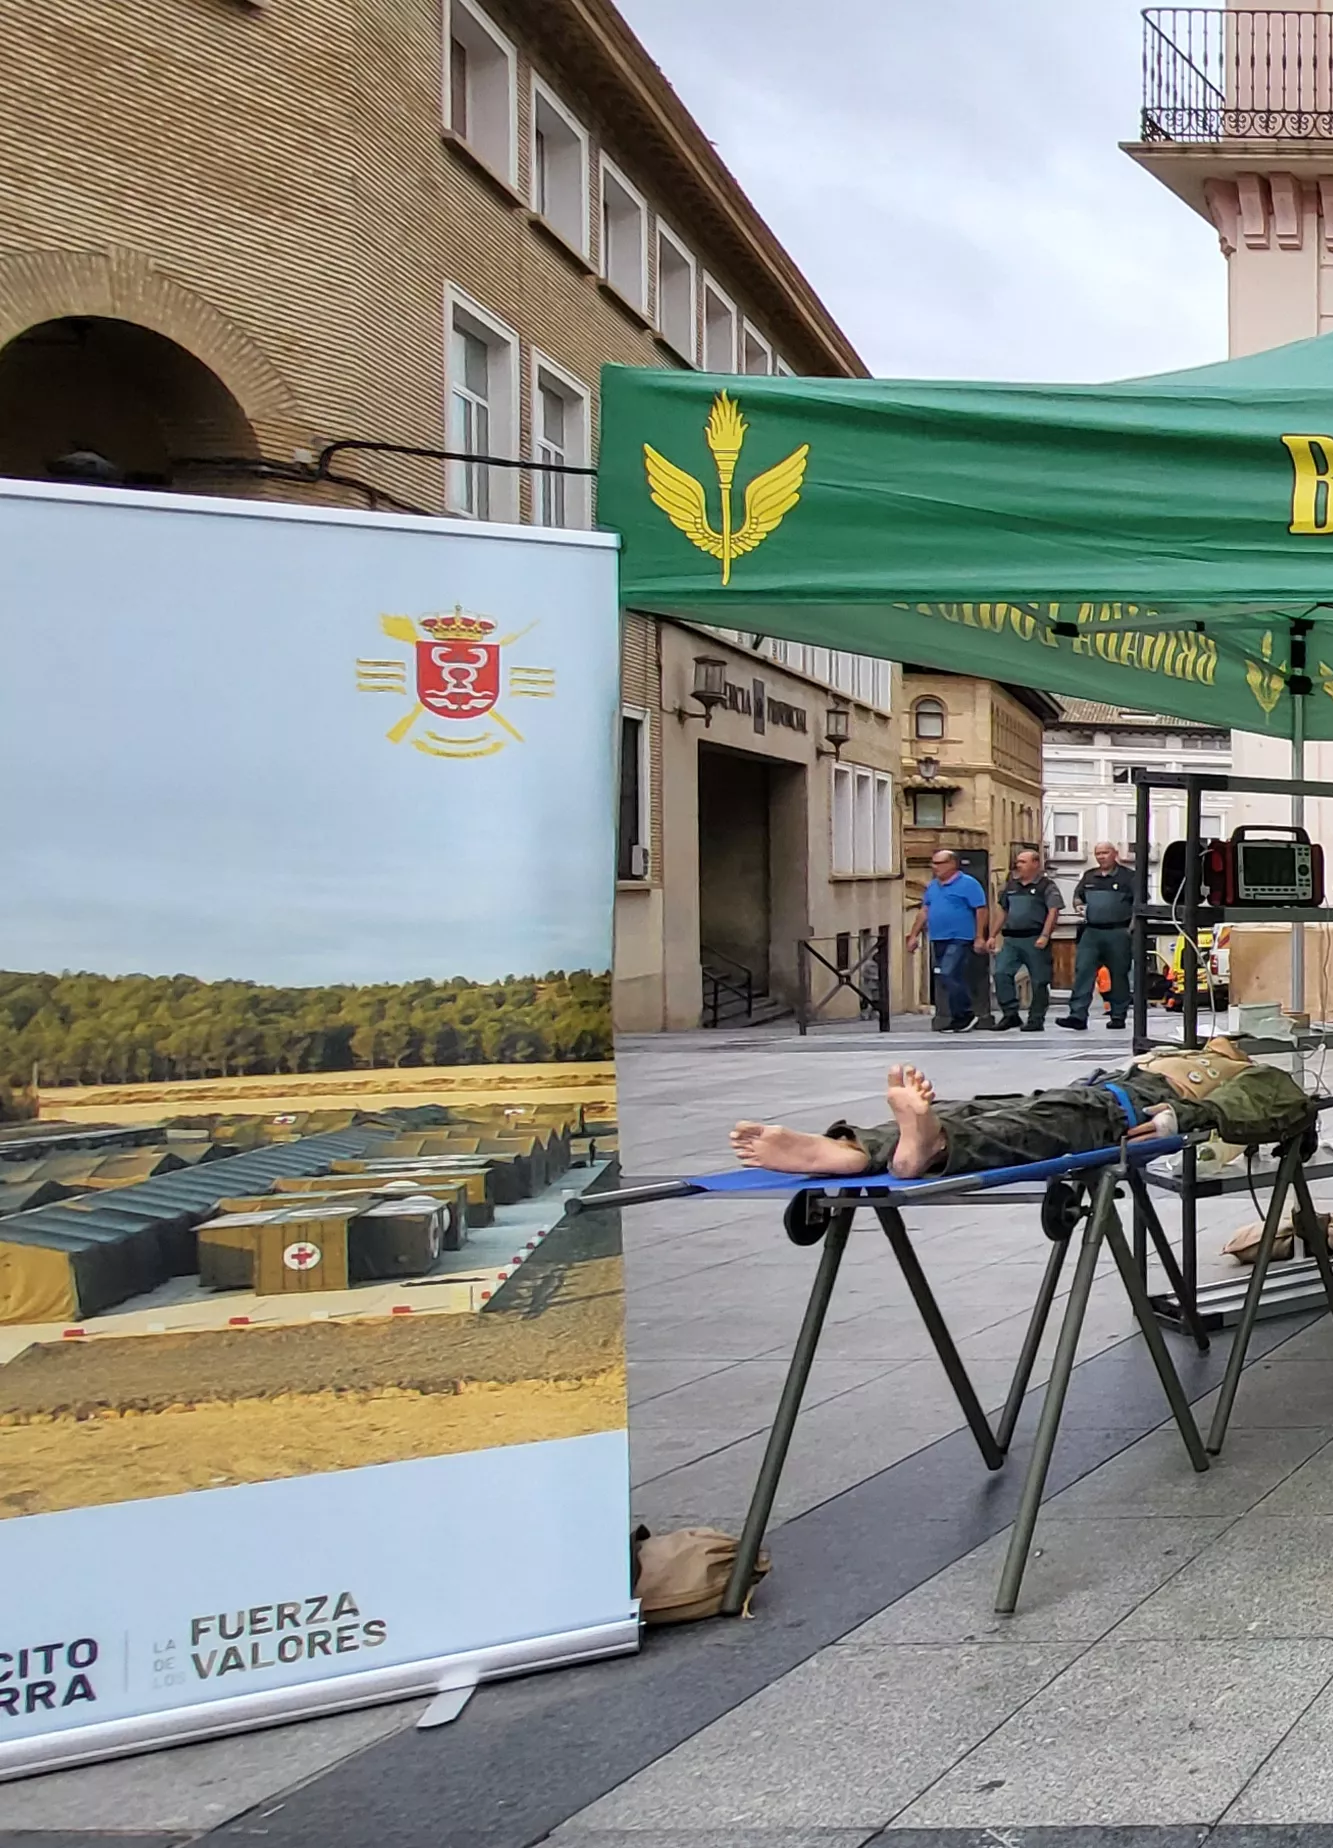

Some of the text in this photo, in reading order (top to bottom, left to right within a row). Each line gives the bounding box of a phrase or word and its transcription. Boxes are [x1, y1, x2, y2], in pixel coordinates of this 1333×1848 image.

[190, 1591, 361, 1647] FUERZA
[0, 1637, 99, 1683] CITO
[152, 1638, 177, 1654] LA
[153, 1655, 175, 1673] DE
[190, 1619, 388, 1680] VALORES
[0, 1673, 97, 1717] RRA
